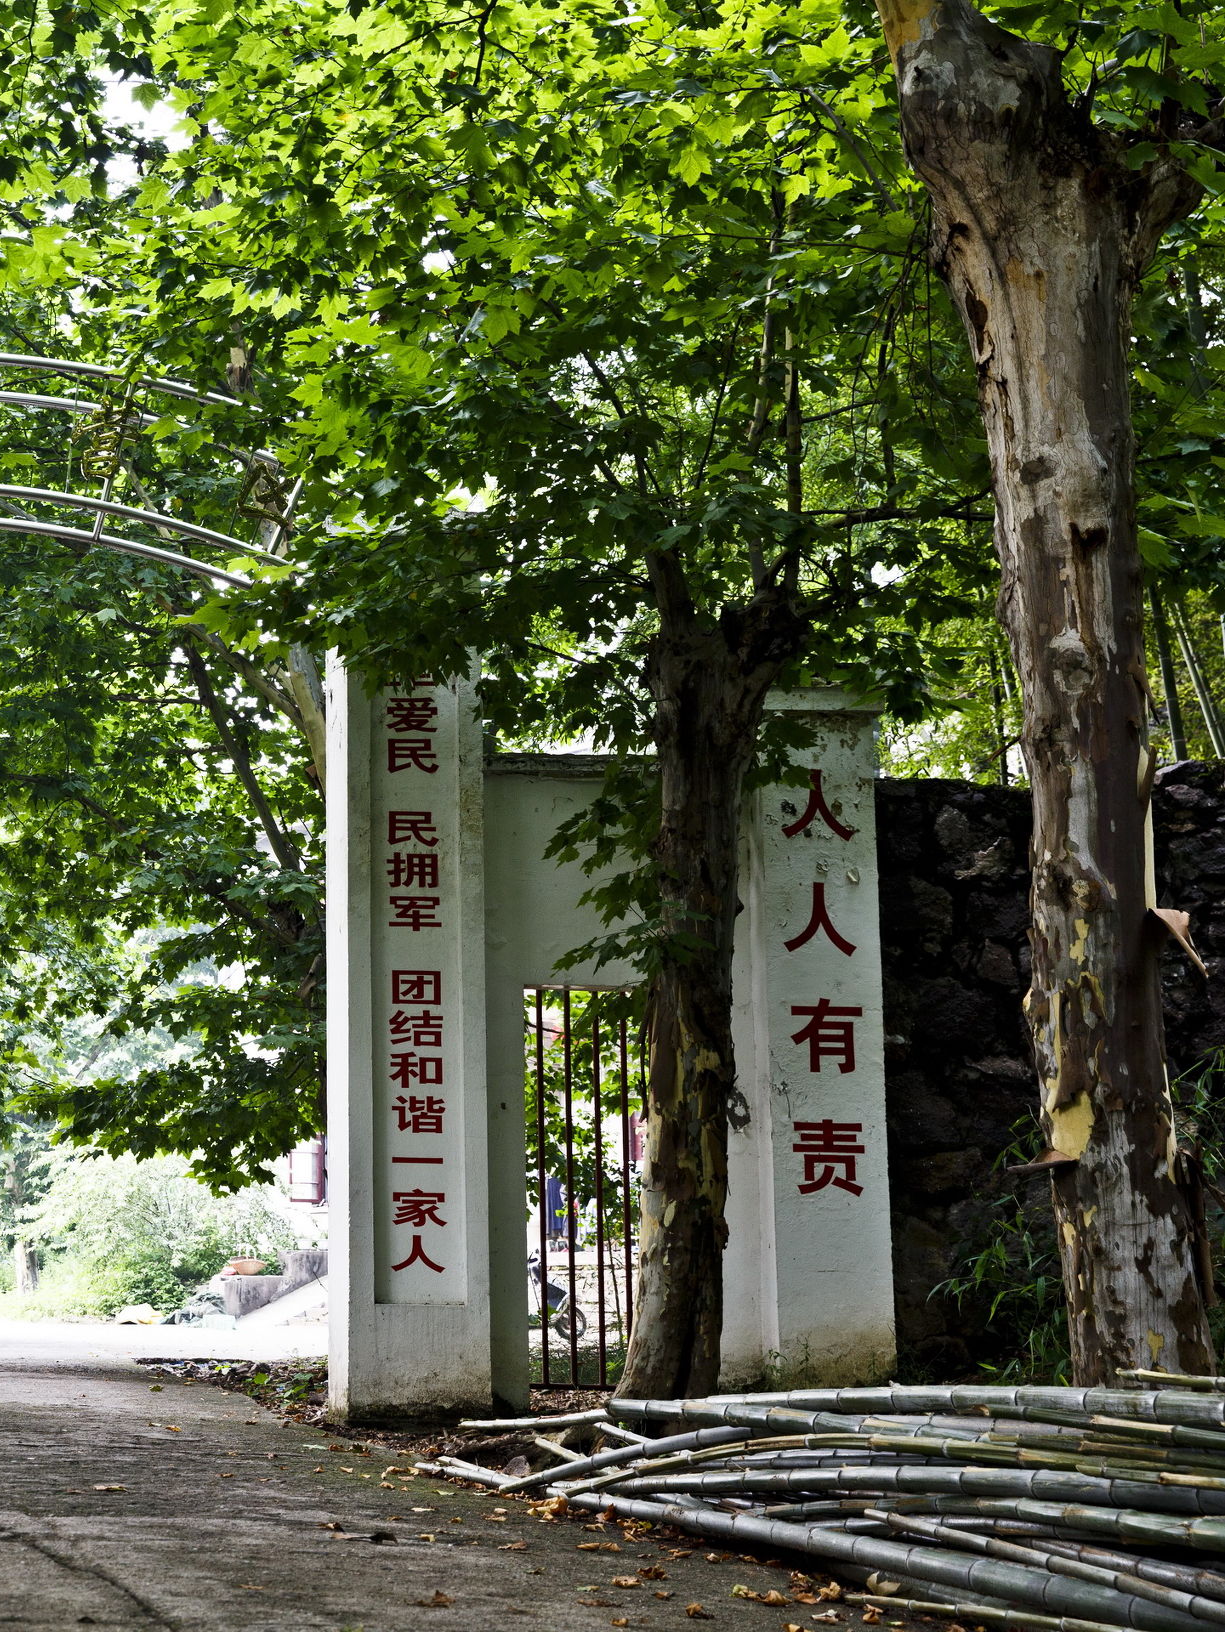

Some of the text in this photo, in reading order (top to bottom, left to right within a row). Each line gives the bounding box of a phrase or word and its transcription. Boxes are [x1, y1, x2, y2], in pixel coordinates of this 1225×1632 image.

[386, 810, 443, 932] 民拥军
[781, 768, 866, 1198] 人人有责
[388, 970, 448, 1274] 团结和谐一家人
